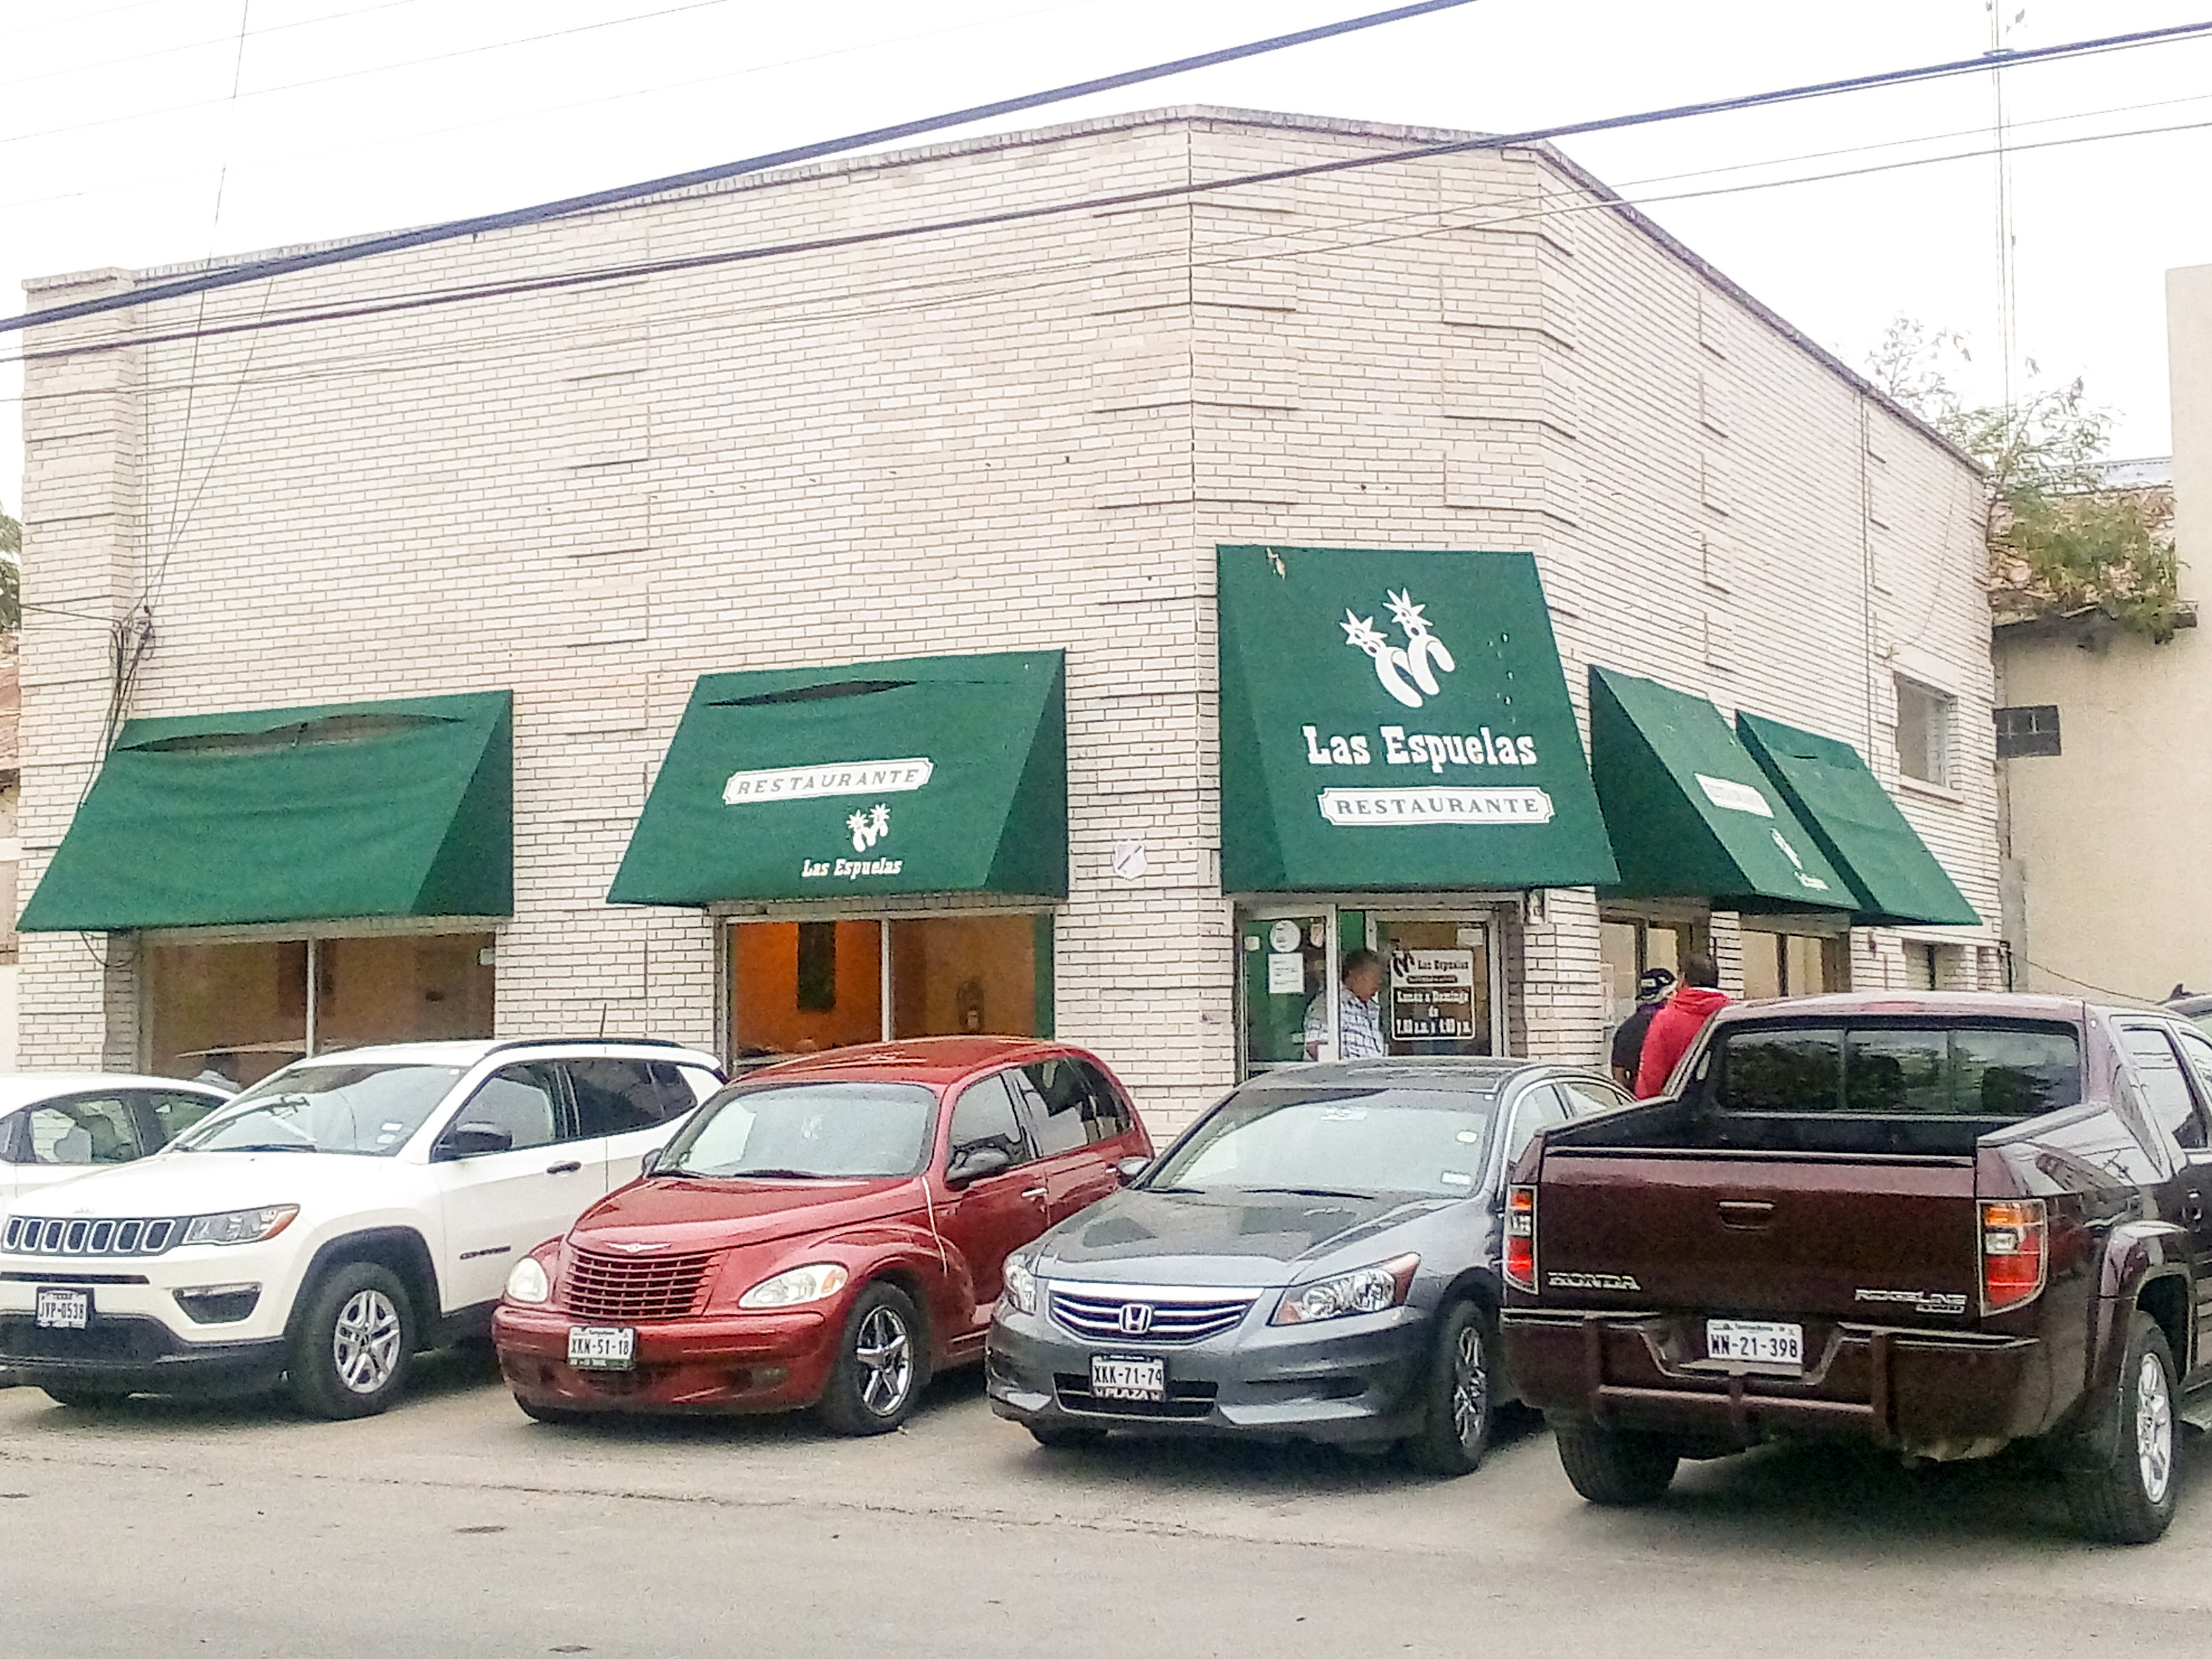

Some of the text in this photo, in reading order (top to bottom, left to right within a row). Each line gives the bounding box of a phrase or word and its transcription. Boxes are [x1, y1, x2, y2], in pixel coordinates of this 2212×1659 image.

[1301, 725, 1538, 773] Las Espuelas
[737, 769, 920, 796] RESTAURANTE
[1334, 798, 1539, 815] RESTAURANTE
[801, 857, 903, 880] Las Espuelas
[1547, 1272, 1641, 1290] HONDA
